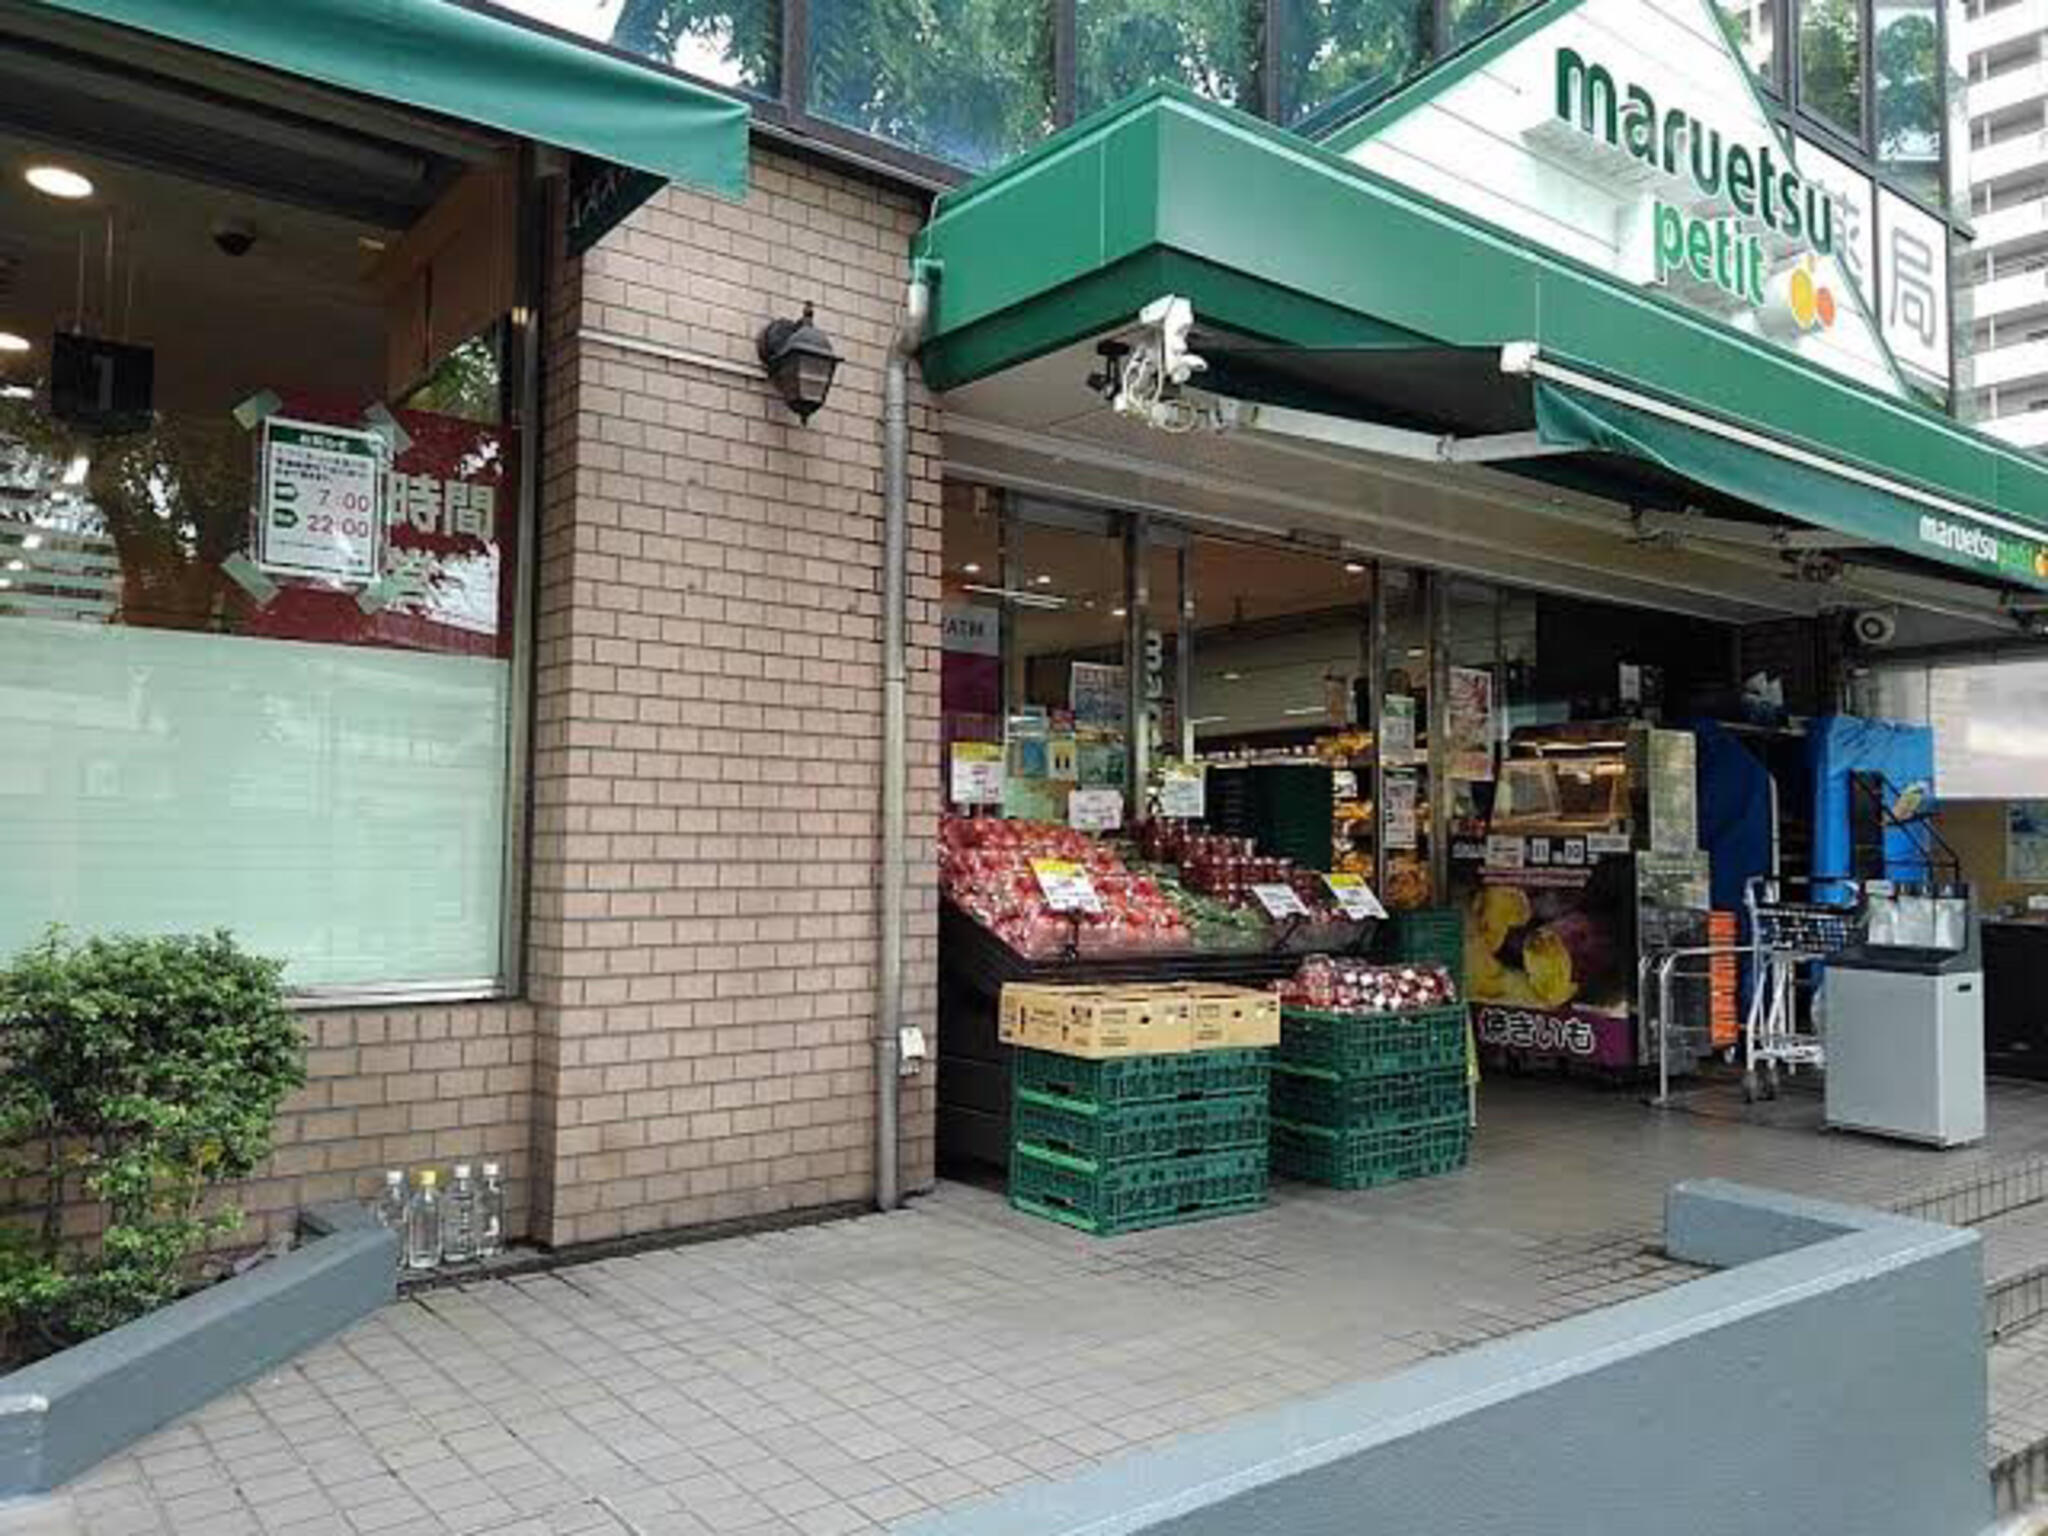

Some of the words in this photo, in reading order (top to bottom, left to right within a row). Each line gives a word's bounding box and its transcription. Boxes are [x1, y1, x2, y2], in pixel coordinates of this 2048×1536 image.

[1556, 47, 1832, 254] maruetsu
[1654, 200, 1765, 308] petit
[306, 514, 369, 538] 22:00
[1920, 514, 1998, 563] maruetsu
